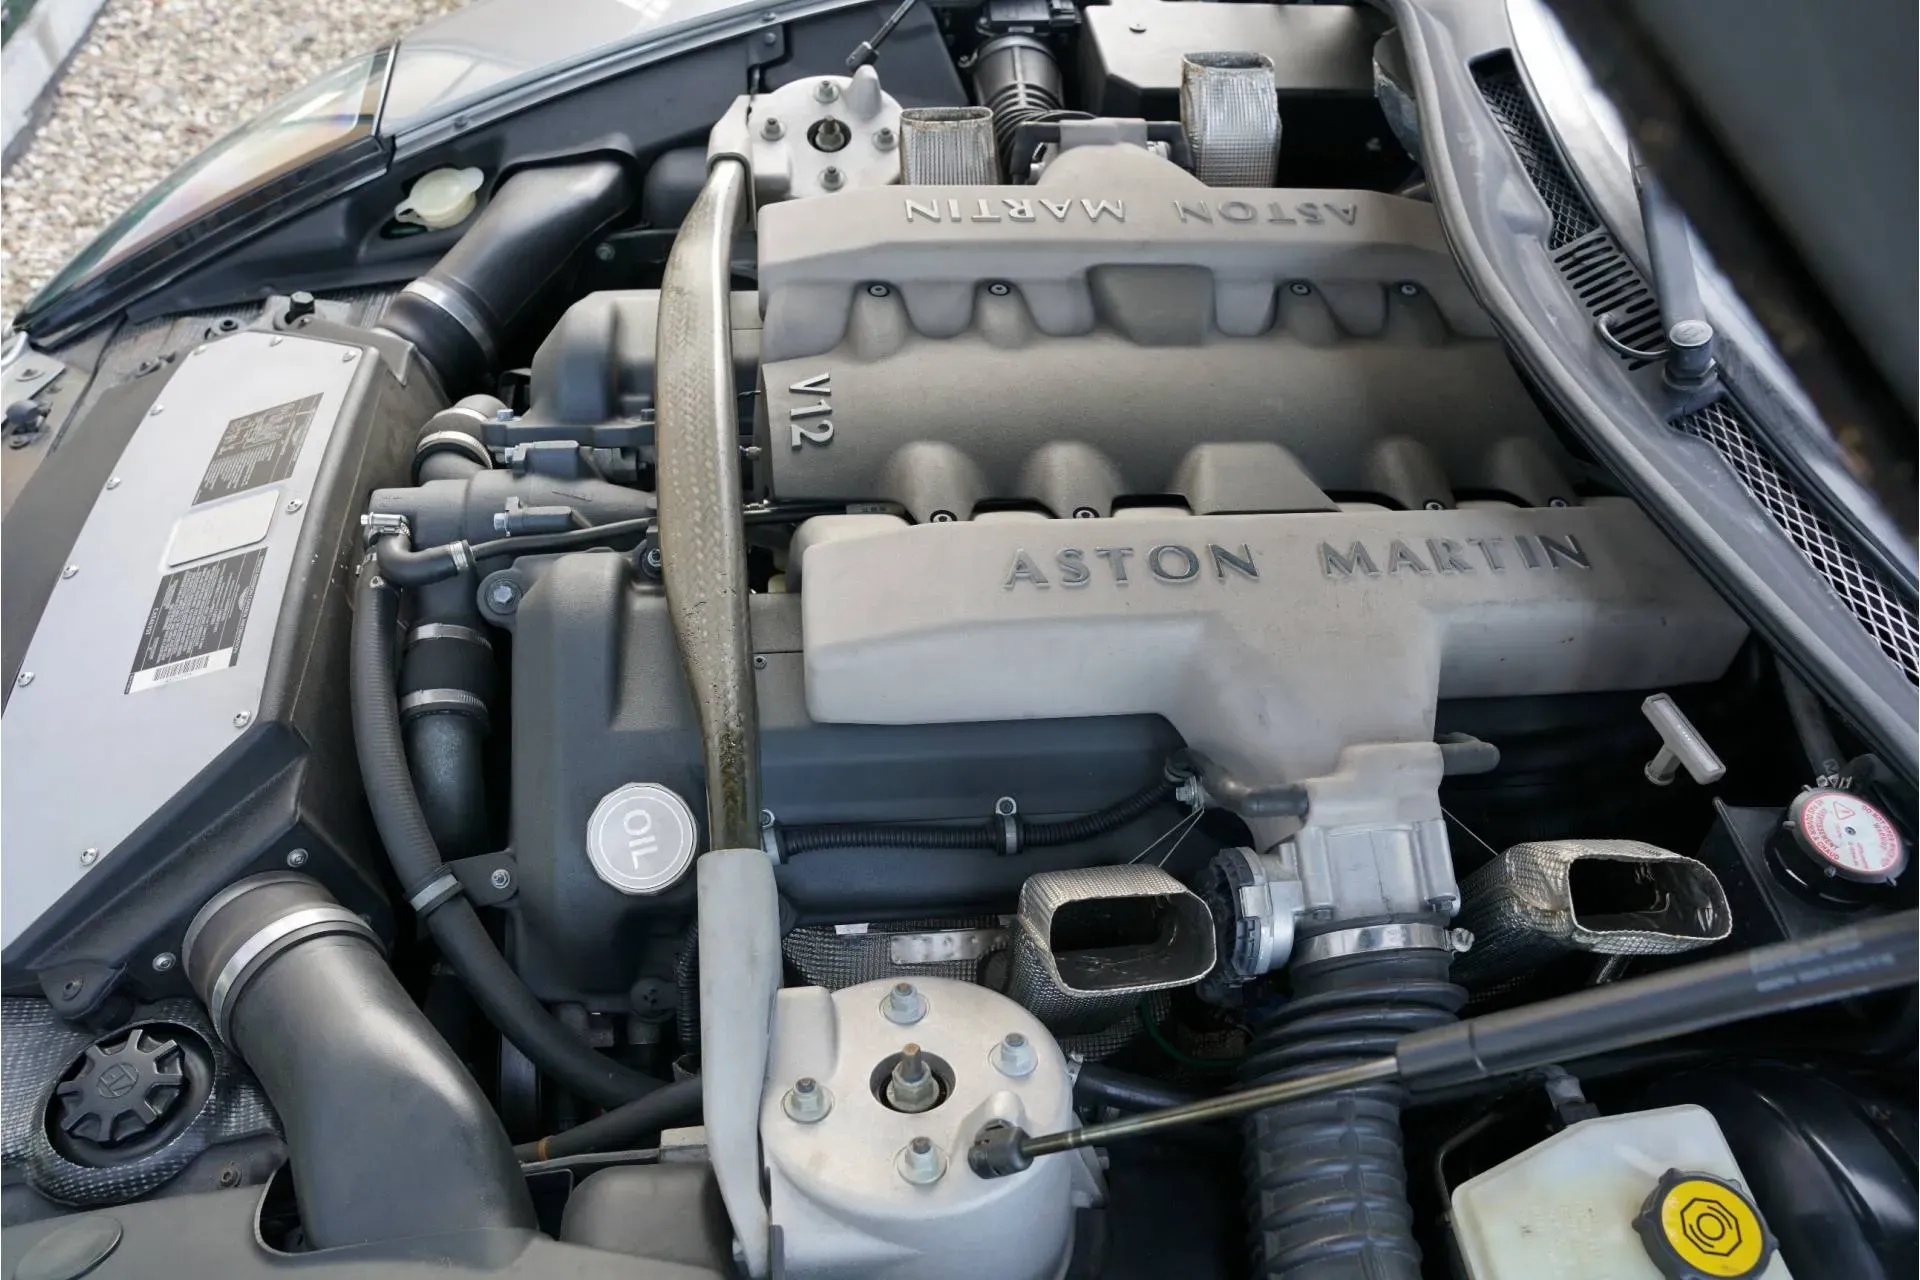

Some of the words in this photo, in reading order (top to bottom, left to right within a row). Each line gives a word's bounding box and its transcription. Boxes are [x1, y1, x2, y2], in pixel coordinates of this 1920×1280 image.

[904, 198, 1126, 223] MARTIN
[1172, 198, 1357, 226] ASTON
[788, 372, 834, 451] V12
[1003, 543, 1260, 589] ASTON
[1317, 534, 1592, 578] MARTIN
[624, 809, 658, 869] OIL
[1817, 841, 1840, 860] CHAUD
